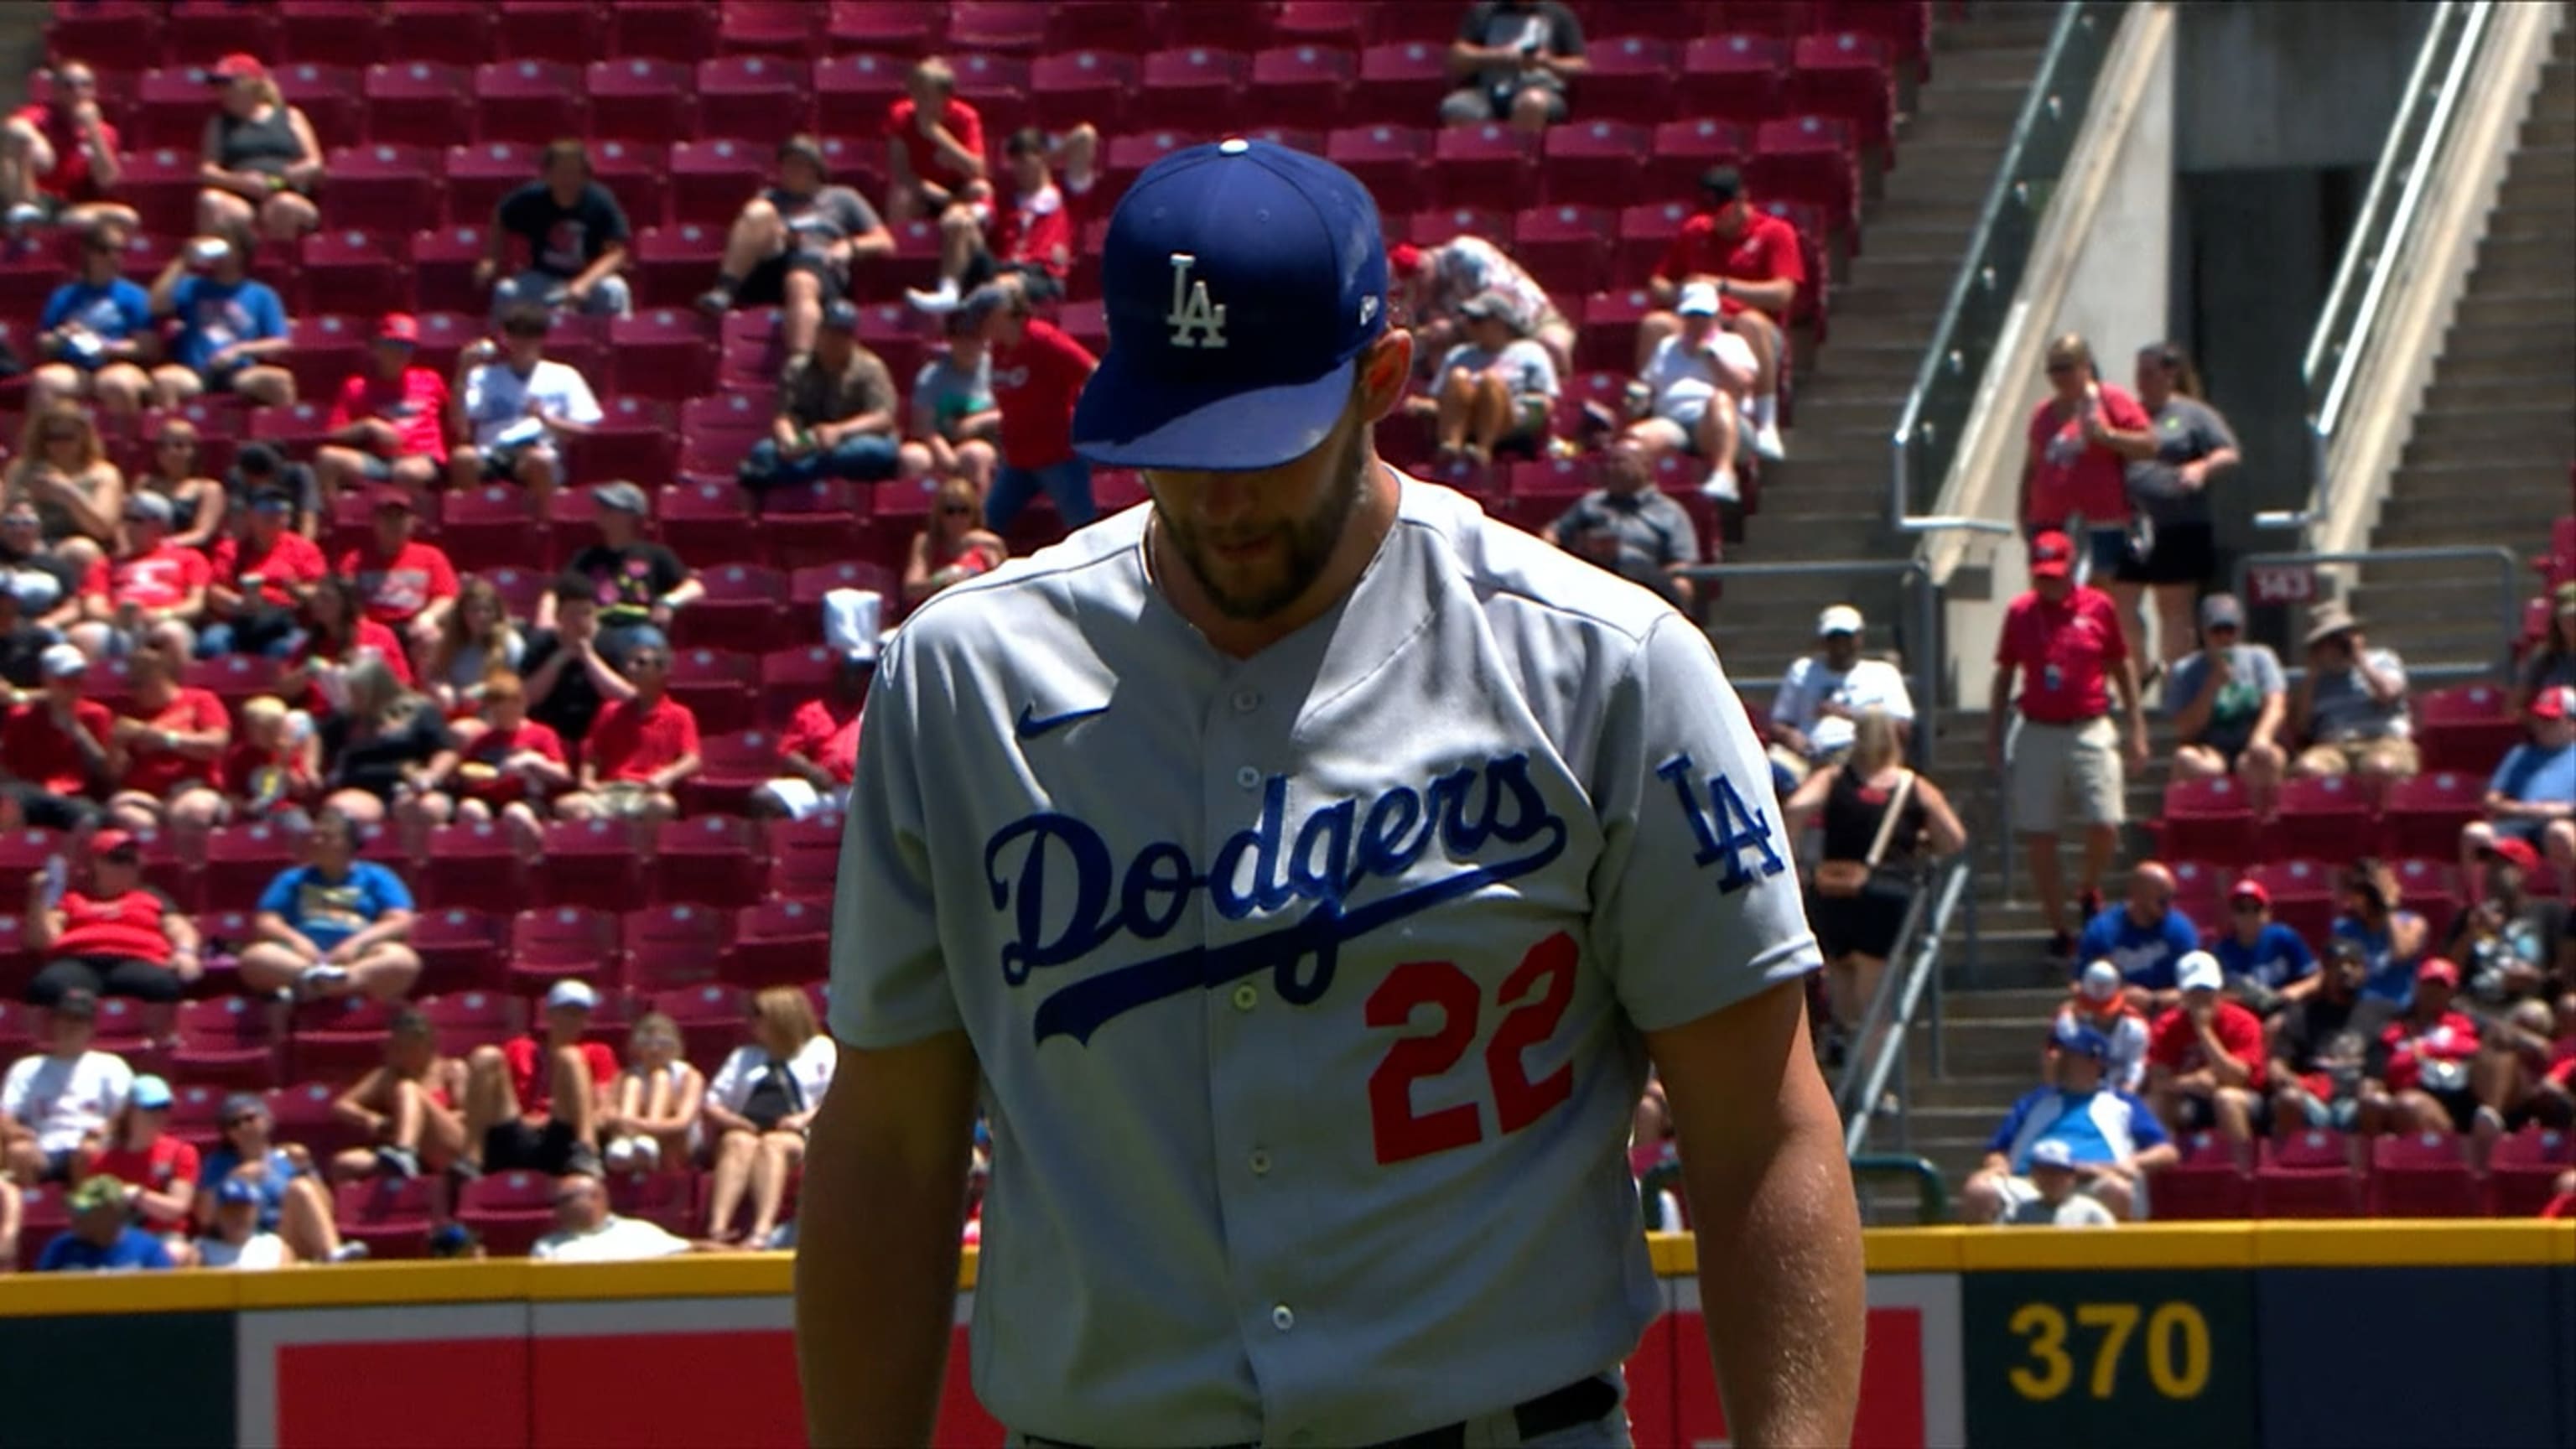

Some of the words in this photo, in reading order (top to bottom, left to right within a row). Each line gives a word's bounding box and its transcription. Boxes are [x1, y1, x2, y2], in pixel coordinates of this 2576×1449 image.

[1166, 253, 1227, 348] LA
[984, 752, 1566, 1005] Dodgers
[1657, 752, 1784, 895] LA
[1364, 931, 1580, 1166] 22
[2009, 1301, 2210, 1400] 370
